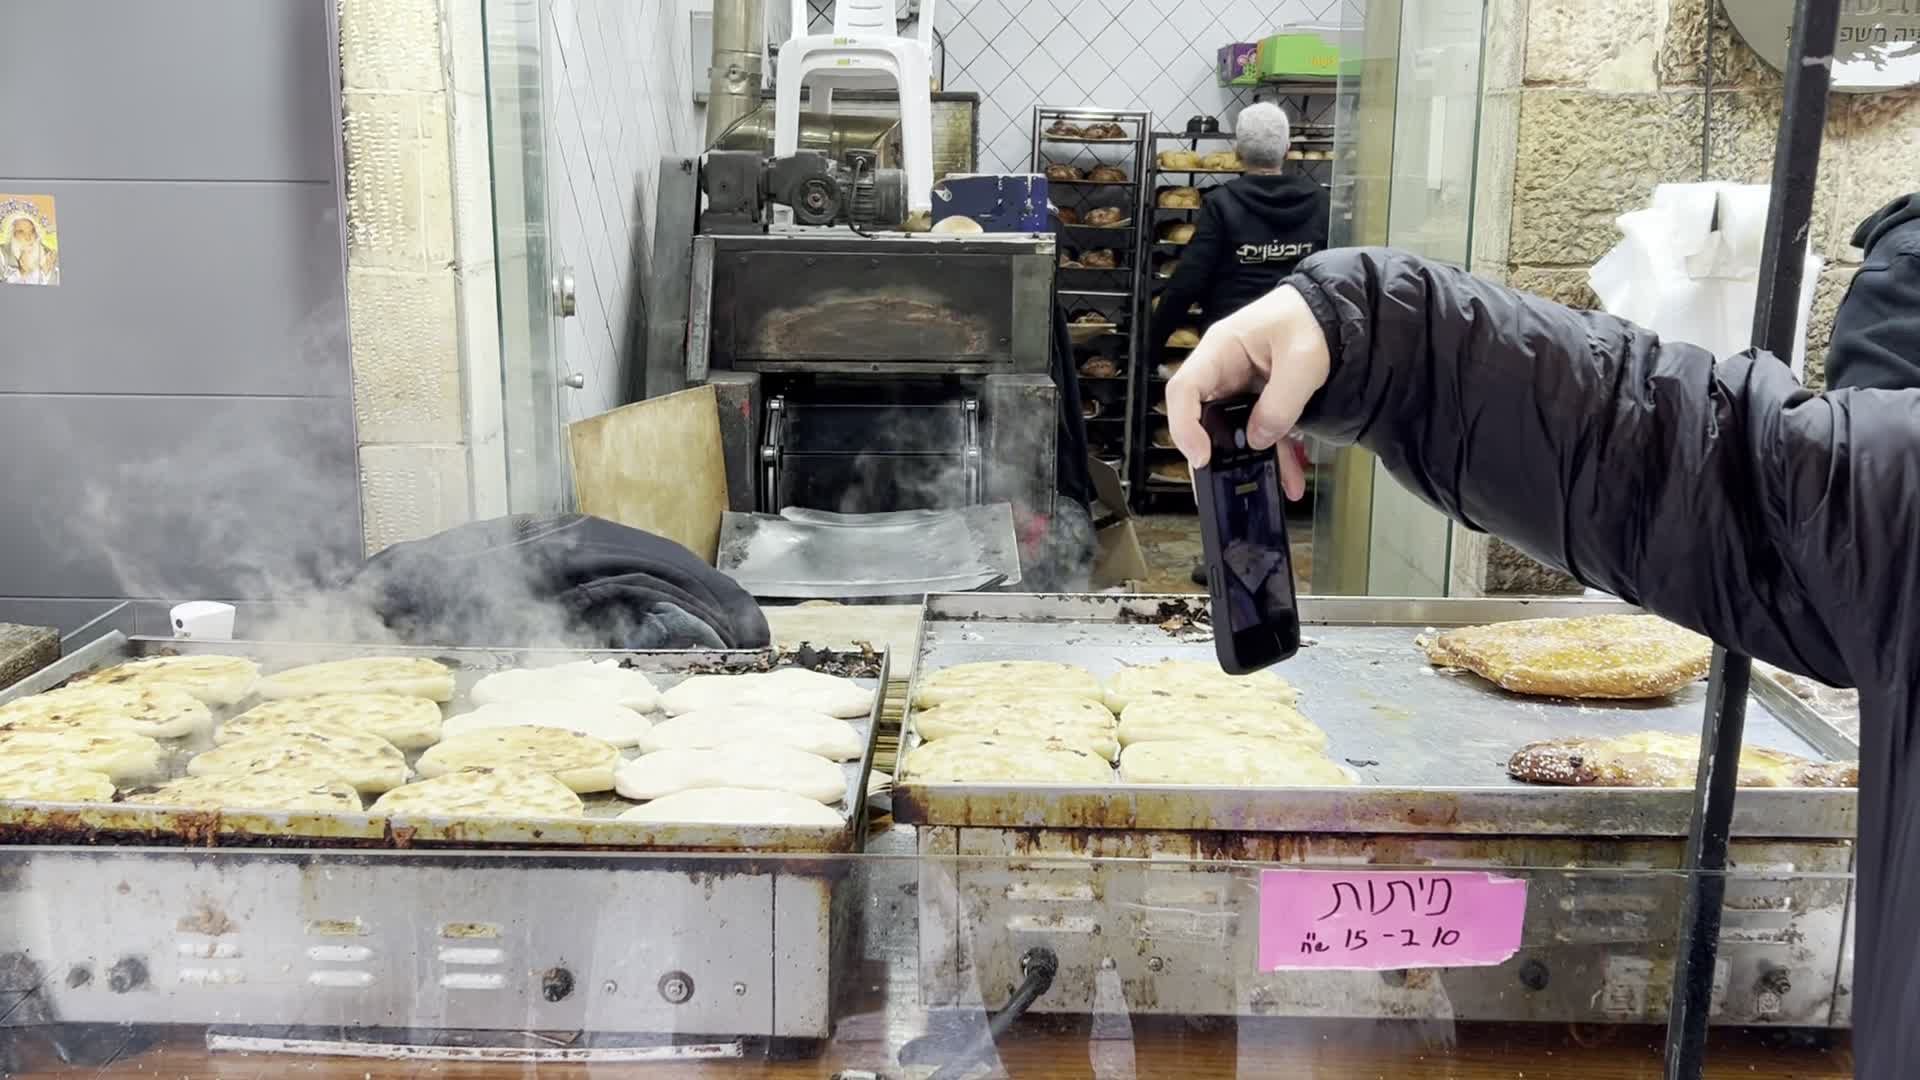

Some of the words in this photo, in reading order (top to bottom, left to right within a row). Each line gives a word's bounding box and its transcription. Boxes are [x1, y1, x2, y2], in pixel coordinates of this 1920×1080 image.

[1317, 877, 1452, 921] פיתות
[1345, 928, 1368, 951] 15
[1431, 926, 1460, 948] 10
